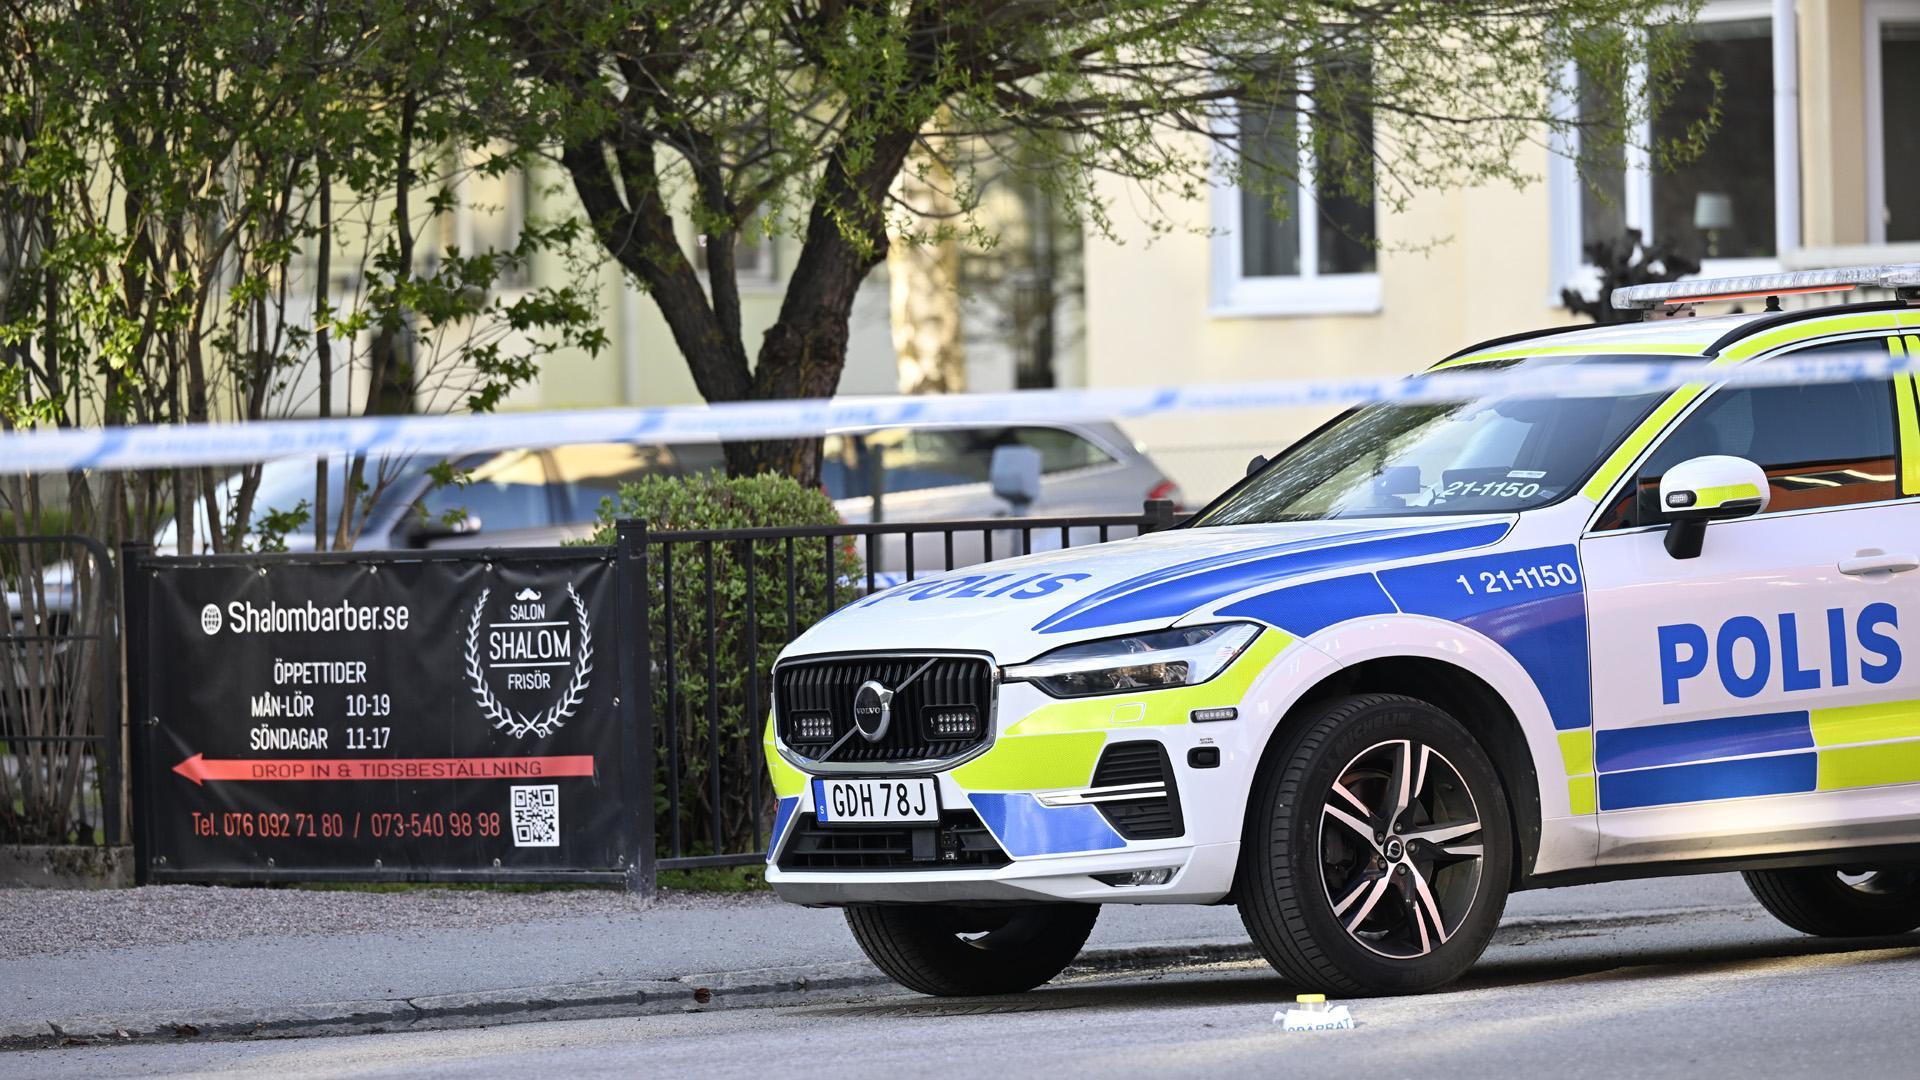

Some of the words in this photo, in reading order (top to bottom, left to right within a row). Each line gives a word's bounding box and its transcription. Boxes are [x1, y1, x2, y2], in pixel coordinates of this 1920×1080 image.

[1446, 481, 1540, 498] 21-1150
[859, 572, 1092, 608] POLIS
[1456, 574, 1474, 595] 1
[1479, 563, 1577, 593] 21-1150
[228, 600, 409, 633] Shalombarber.se
[510, 603, 545, 620] SALON
[489, 629, 571, 660] SHALOM
[1657, 602, 1902, 705] POLIS
[274, 658, 367, 685] ÖPPETTIDER
[508, 669, 551, 690] FRISÖR
[251, 691, 314, 717] MÅN-LÖR
[346, 694, 391, 716] 10-19
[856, 707, 881, 715] VOLVO
[250, 724, 328, 750] SÖNDAGAR
[346, 727, 391, 749] 11-17
[252, 764, 304, 778] DROP
[311, 764, 330, 778] IN
[338, 764, 352, 778] &
[360, 759, 542, 778] TIDSBESTÄLLNING
[819, 805, 825, 815] S
[833, 783, 874, 817] GDH
[879, 783, 926, 816] 78J
[192, 812, 219, 836] Tel.
[223, 813, 254, 837] 076
[258, 813, 290, 837] 092
[295, 813, 317, 837] 71
[321, 813, 343, 837] 80
[353, 812, 361, 838] /
[371, 812, 444, 837] 073-540
[450, 812, 473, 836] 98
[478, 812, 501, 836] 98
